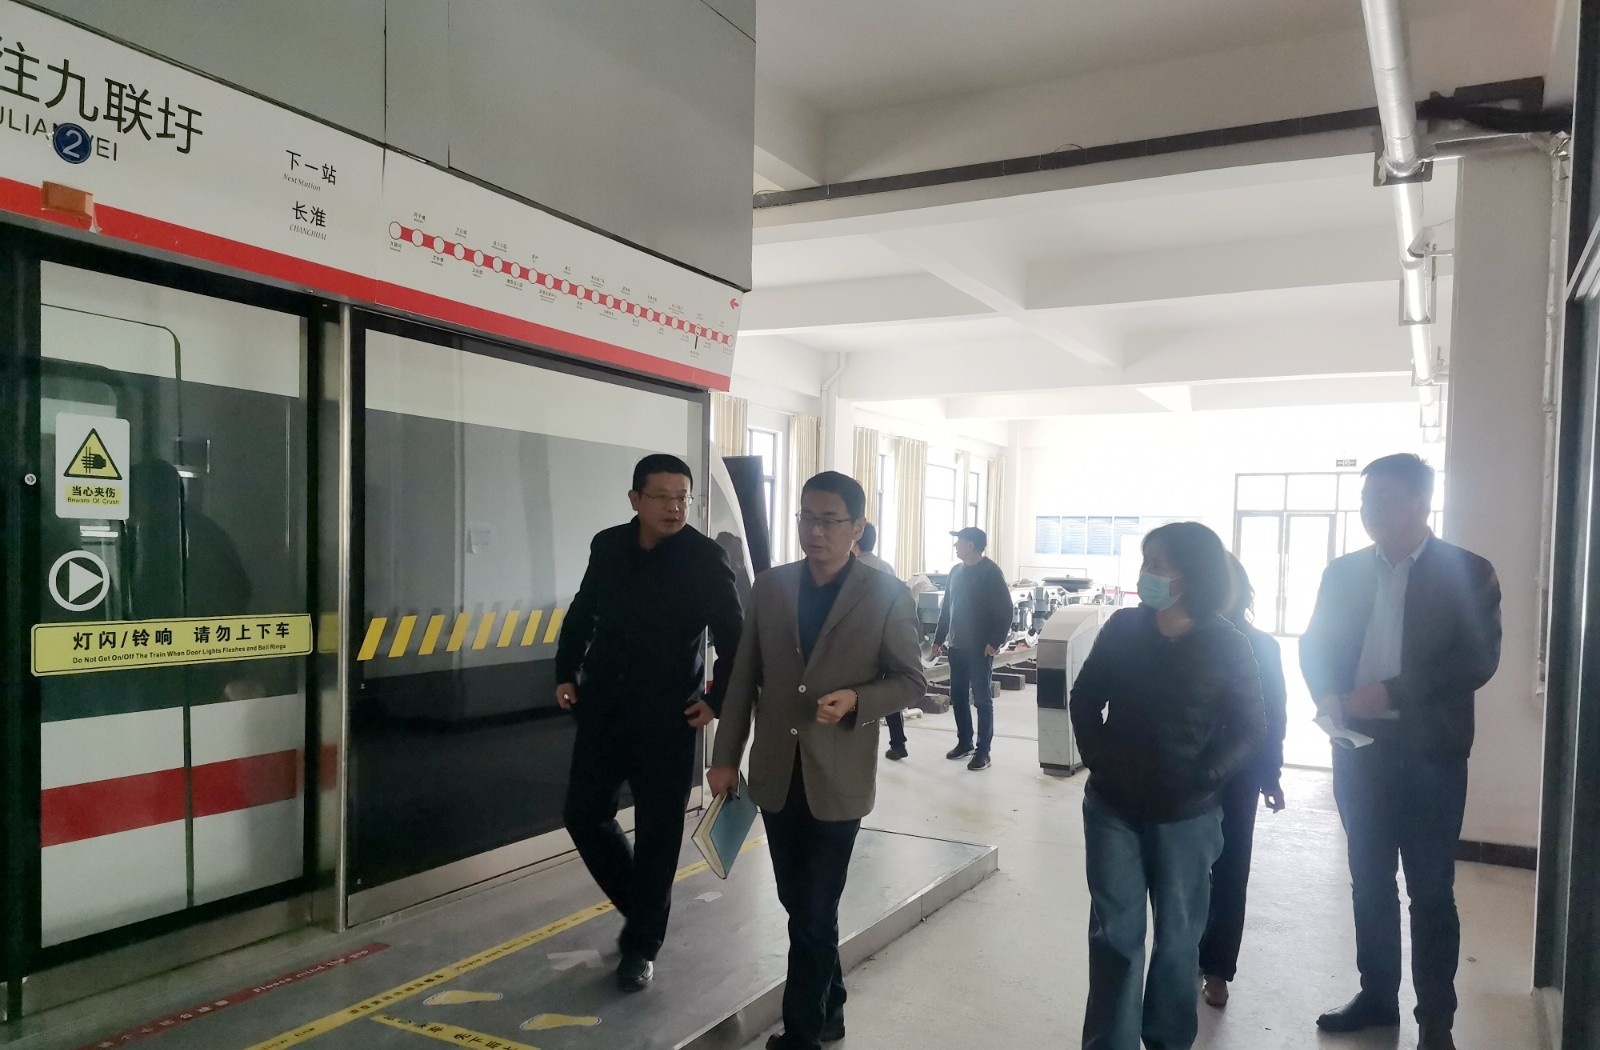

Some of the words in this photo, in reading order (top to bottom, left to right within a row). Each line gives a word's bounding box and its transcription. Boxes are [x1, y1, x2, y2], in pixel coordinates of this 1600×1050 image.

[63, 129, 83, 158] 2
[285, 149, 337, 185] 下一站
[283, 173, 298, 185] Next
[297, 178, 321, 191] Station
[291, 201, 327, 228] 长淮
[72, 486, 116, 498] 当心夹伤
[72, 627, 173, 650] 灯闪/铃响
[194, 622, 290, 643] 请勿上下车
[84, 655, 97, 663] Not
[98, 654, 111, 662] Get
[186, 648, 201, 656] Door
[202, 648, 221, 656] Lights
